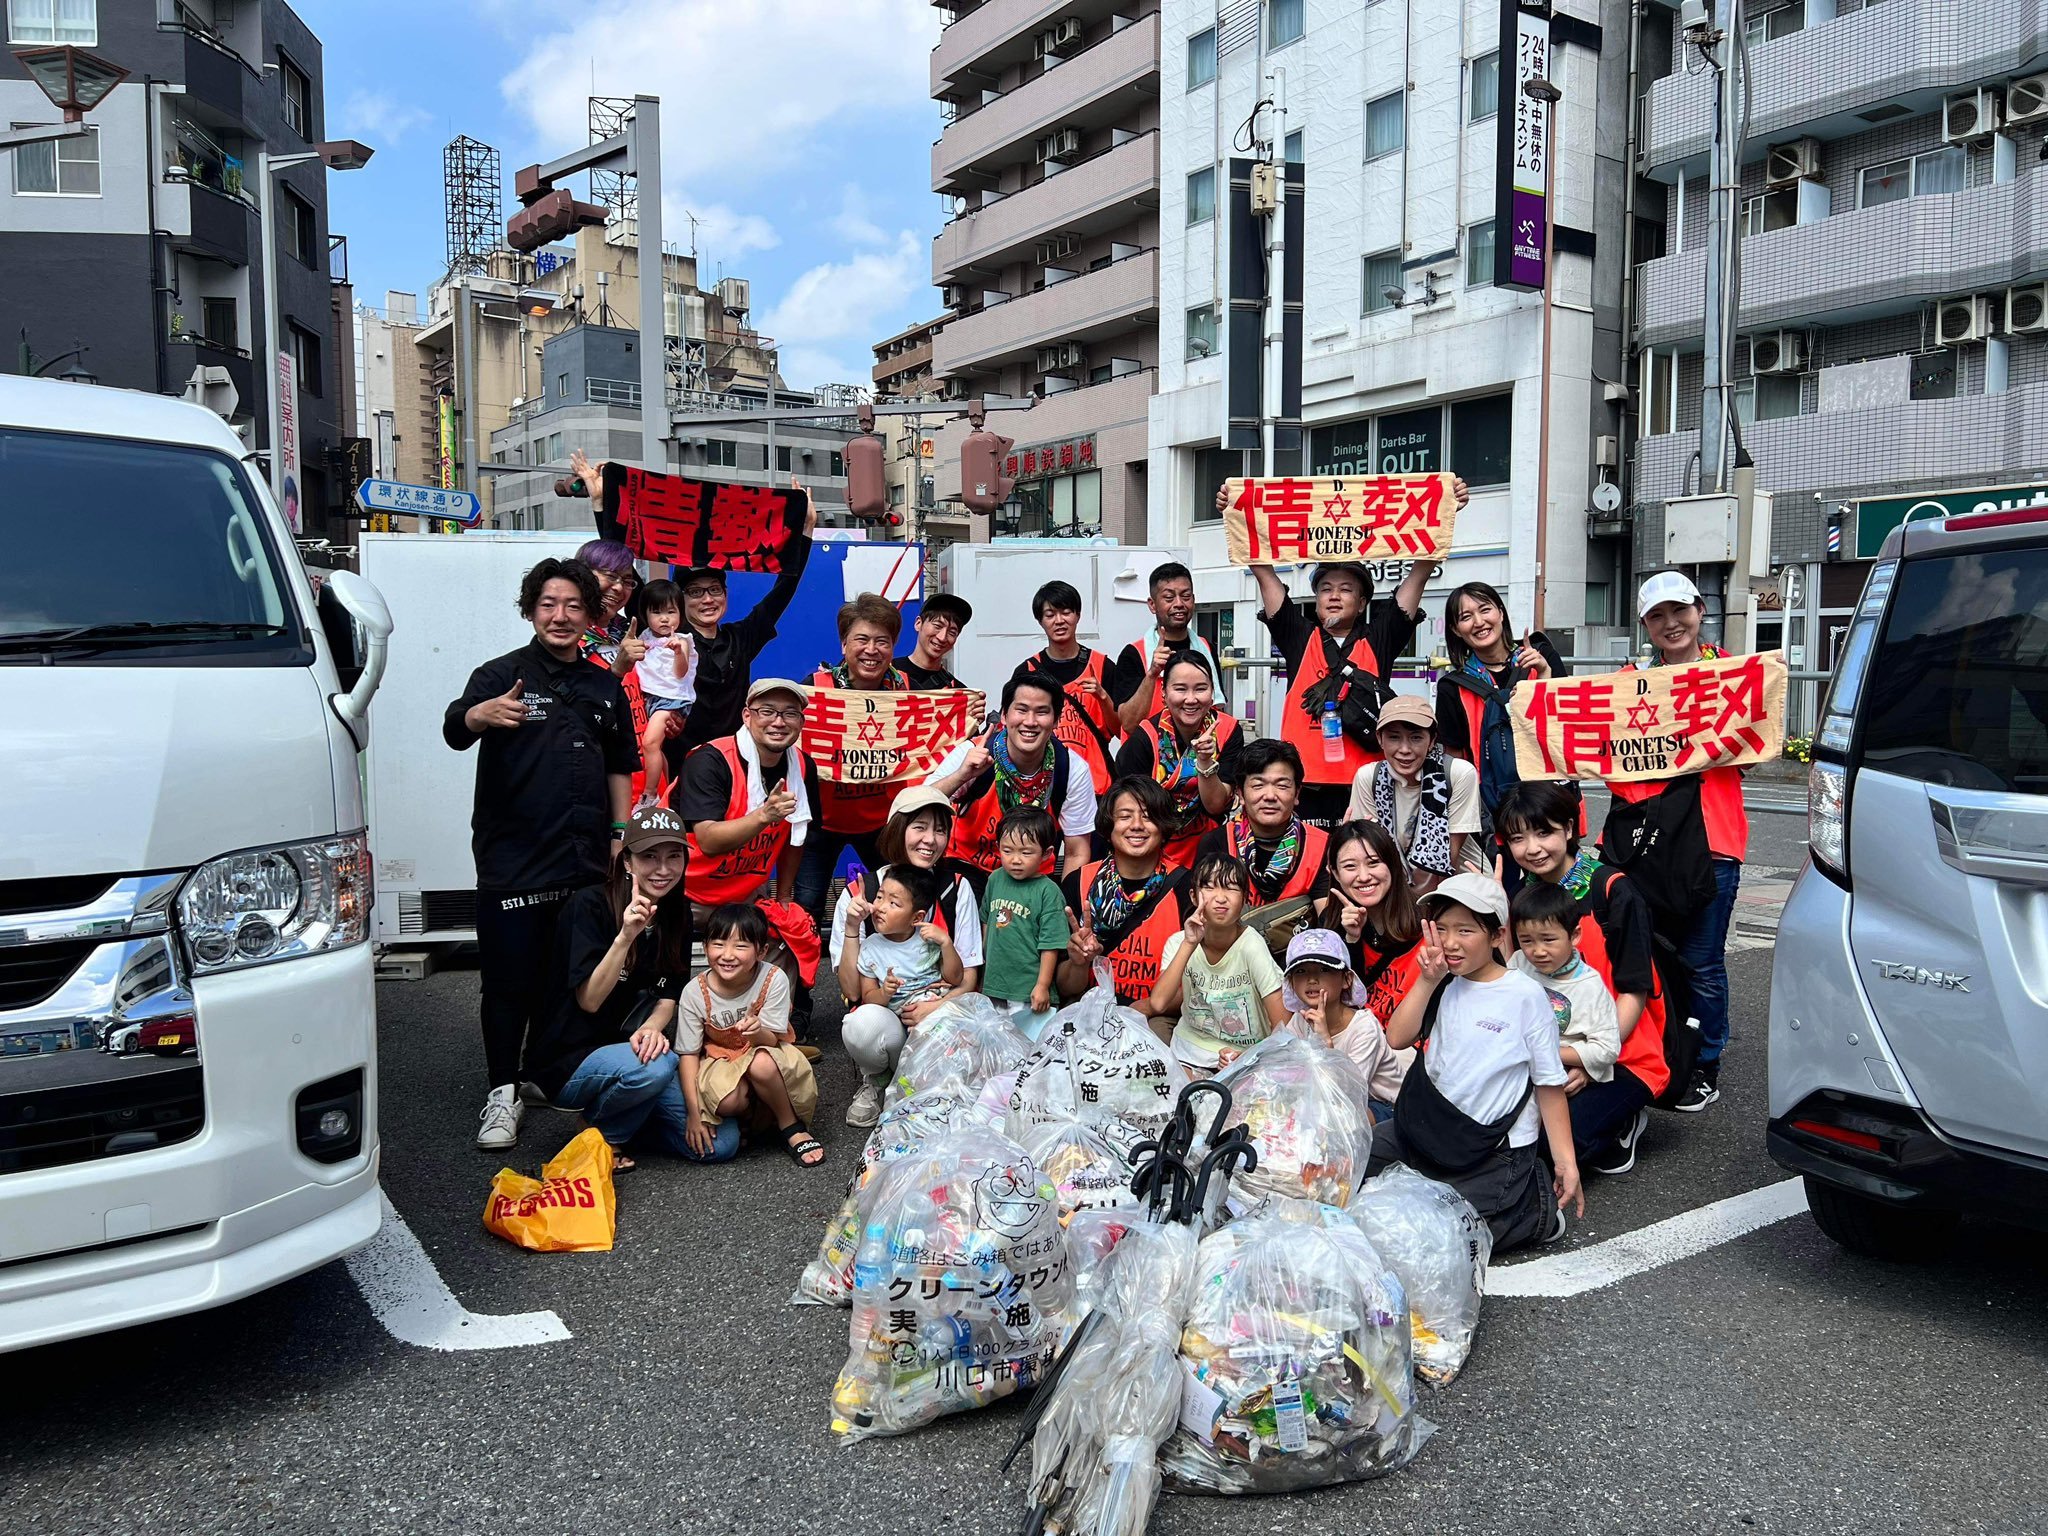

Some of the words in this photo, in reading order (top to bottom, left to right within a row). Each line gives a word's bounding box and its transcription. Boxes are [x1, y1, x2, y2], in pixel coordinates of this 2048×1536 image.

[1514, 244, 1540, 255] ANYTIME
[279, 355, 295, 471] 無料案内所
[1333, 444, 1362, 457] Dining
[1381, 436, 1407, 448] Darts
[1409, 433, 1427, 444] Bar
[378, 485, 463, 507] 環状線通り
[395, 499, 448, 513] Kanjosen-dori
[1234, 478, 1313, 559] 情
[1358, 474, 1443, 556] 熱
[1297, 526, 1374, 542] JYONETSU
[1316, 541, 1352, 555] CLUB
[1525, 681, 1614, 774] 情
[1670, 655, 1767, 769] 熱
[1598, 732, 1690, 757] JYONETSU
[832, 749, 907, 764] JYONETSU
[1622, 754, 1668, 772] CLUB
[850, 765, 888, 779] CLUB
[652, 812, 670, 829] NY
[501, 897, 525, 911] ESTA
[990, 898, 1031, 919] HUNGRY
[656, 977, 667, 988] R
[1871, 959, 1971, 993] TANK
[1154, 1083, 1171, 1100] 中
[889, 1310, 917, 1334] 実
[1005, 1302, 1031, 1327] 施
